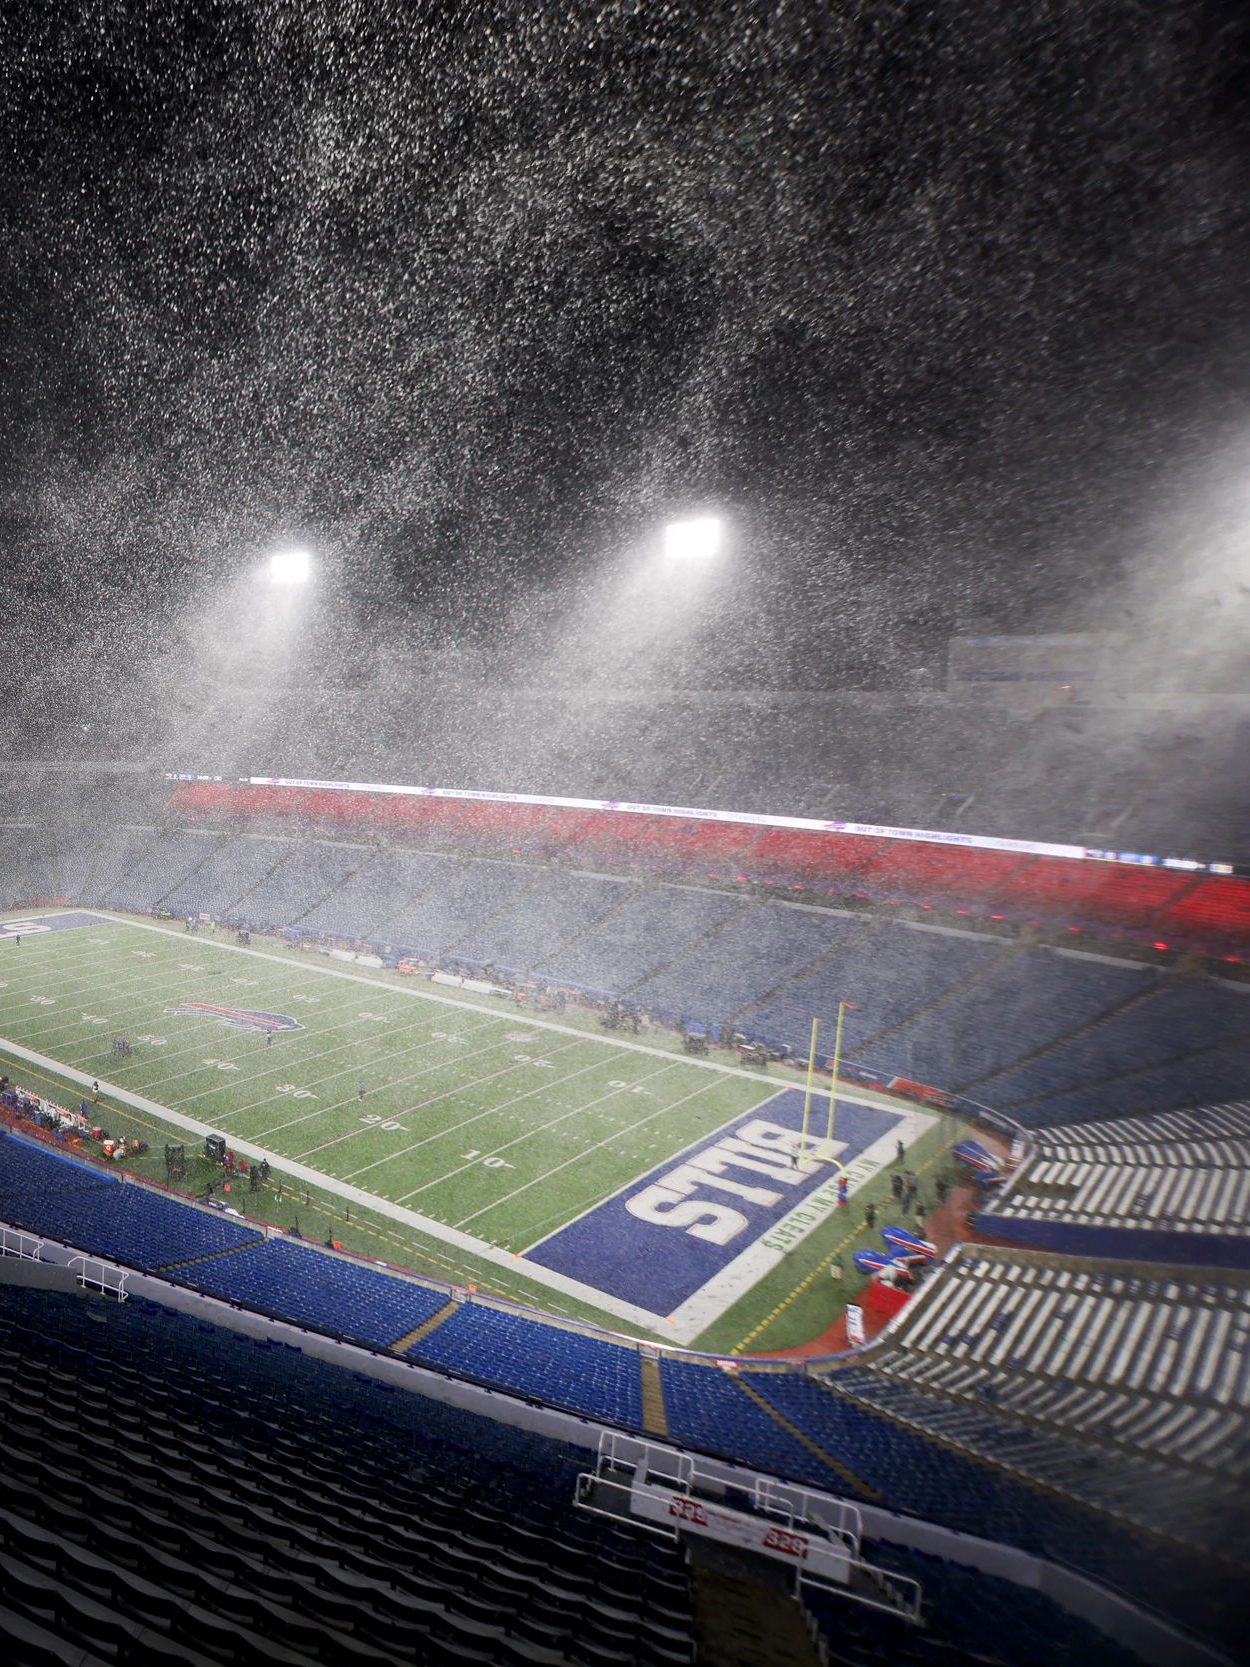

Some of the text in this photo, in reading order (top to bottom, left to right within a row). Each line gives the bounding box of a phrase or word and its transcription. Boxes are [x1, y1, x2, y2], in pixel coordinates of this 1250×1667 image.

[276, 1084, 312, 1098] 30
[359, 1114, 401, 1131] 20
[460, 1149, 505, 1168] 10
[625, 1118, 850, 1246] BILLS
[806, 1196, 834, 1213] MY
[762, 1212, 817, 1251] CLEATS
